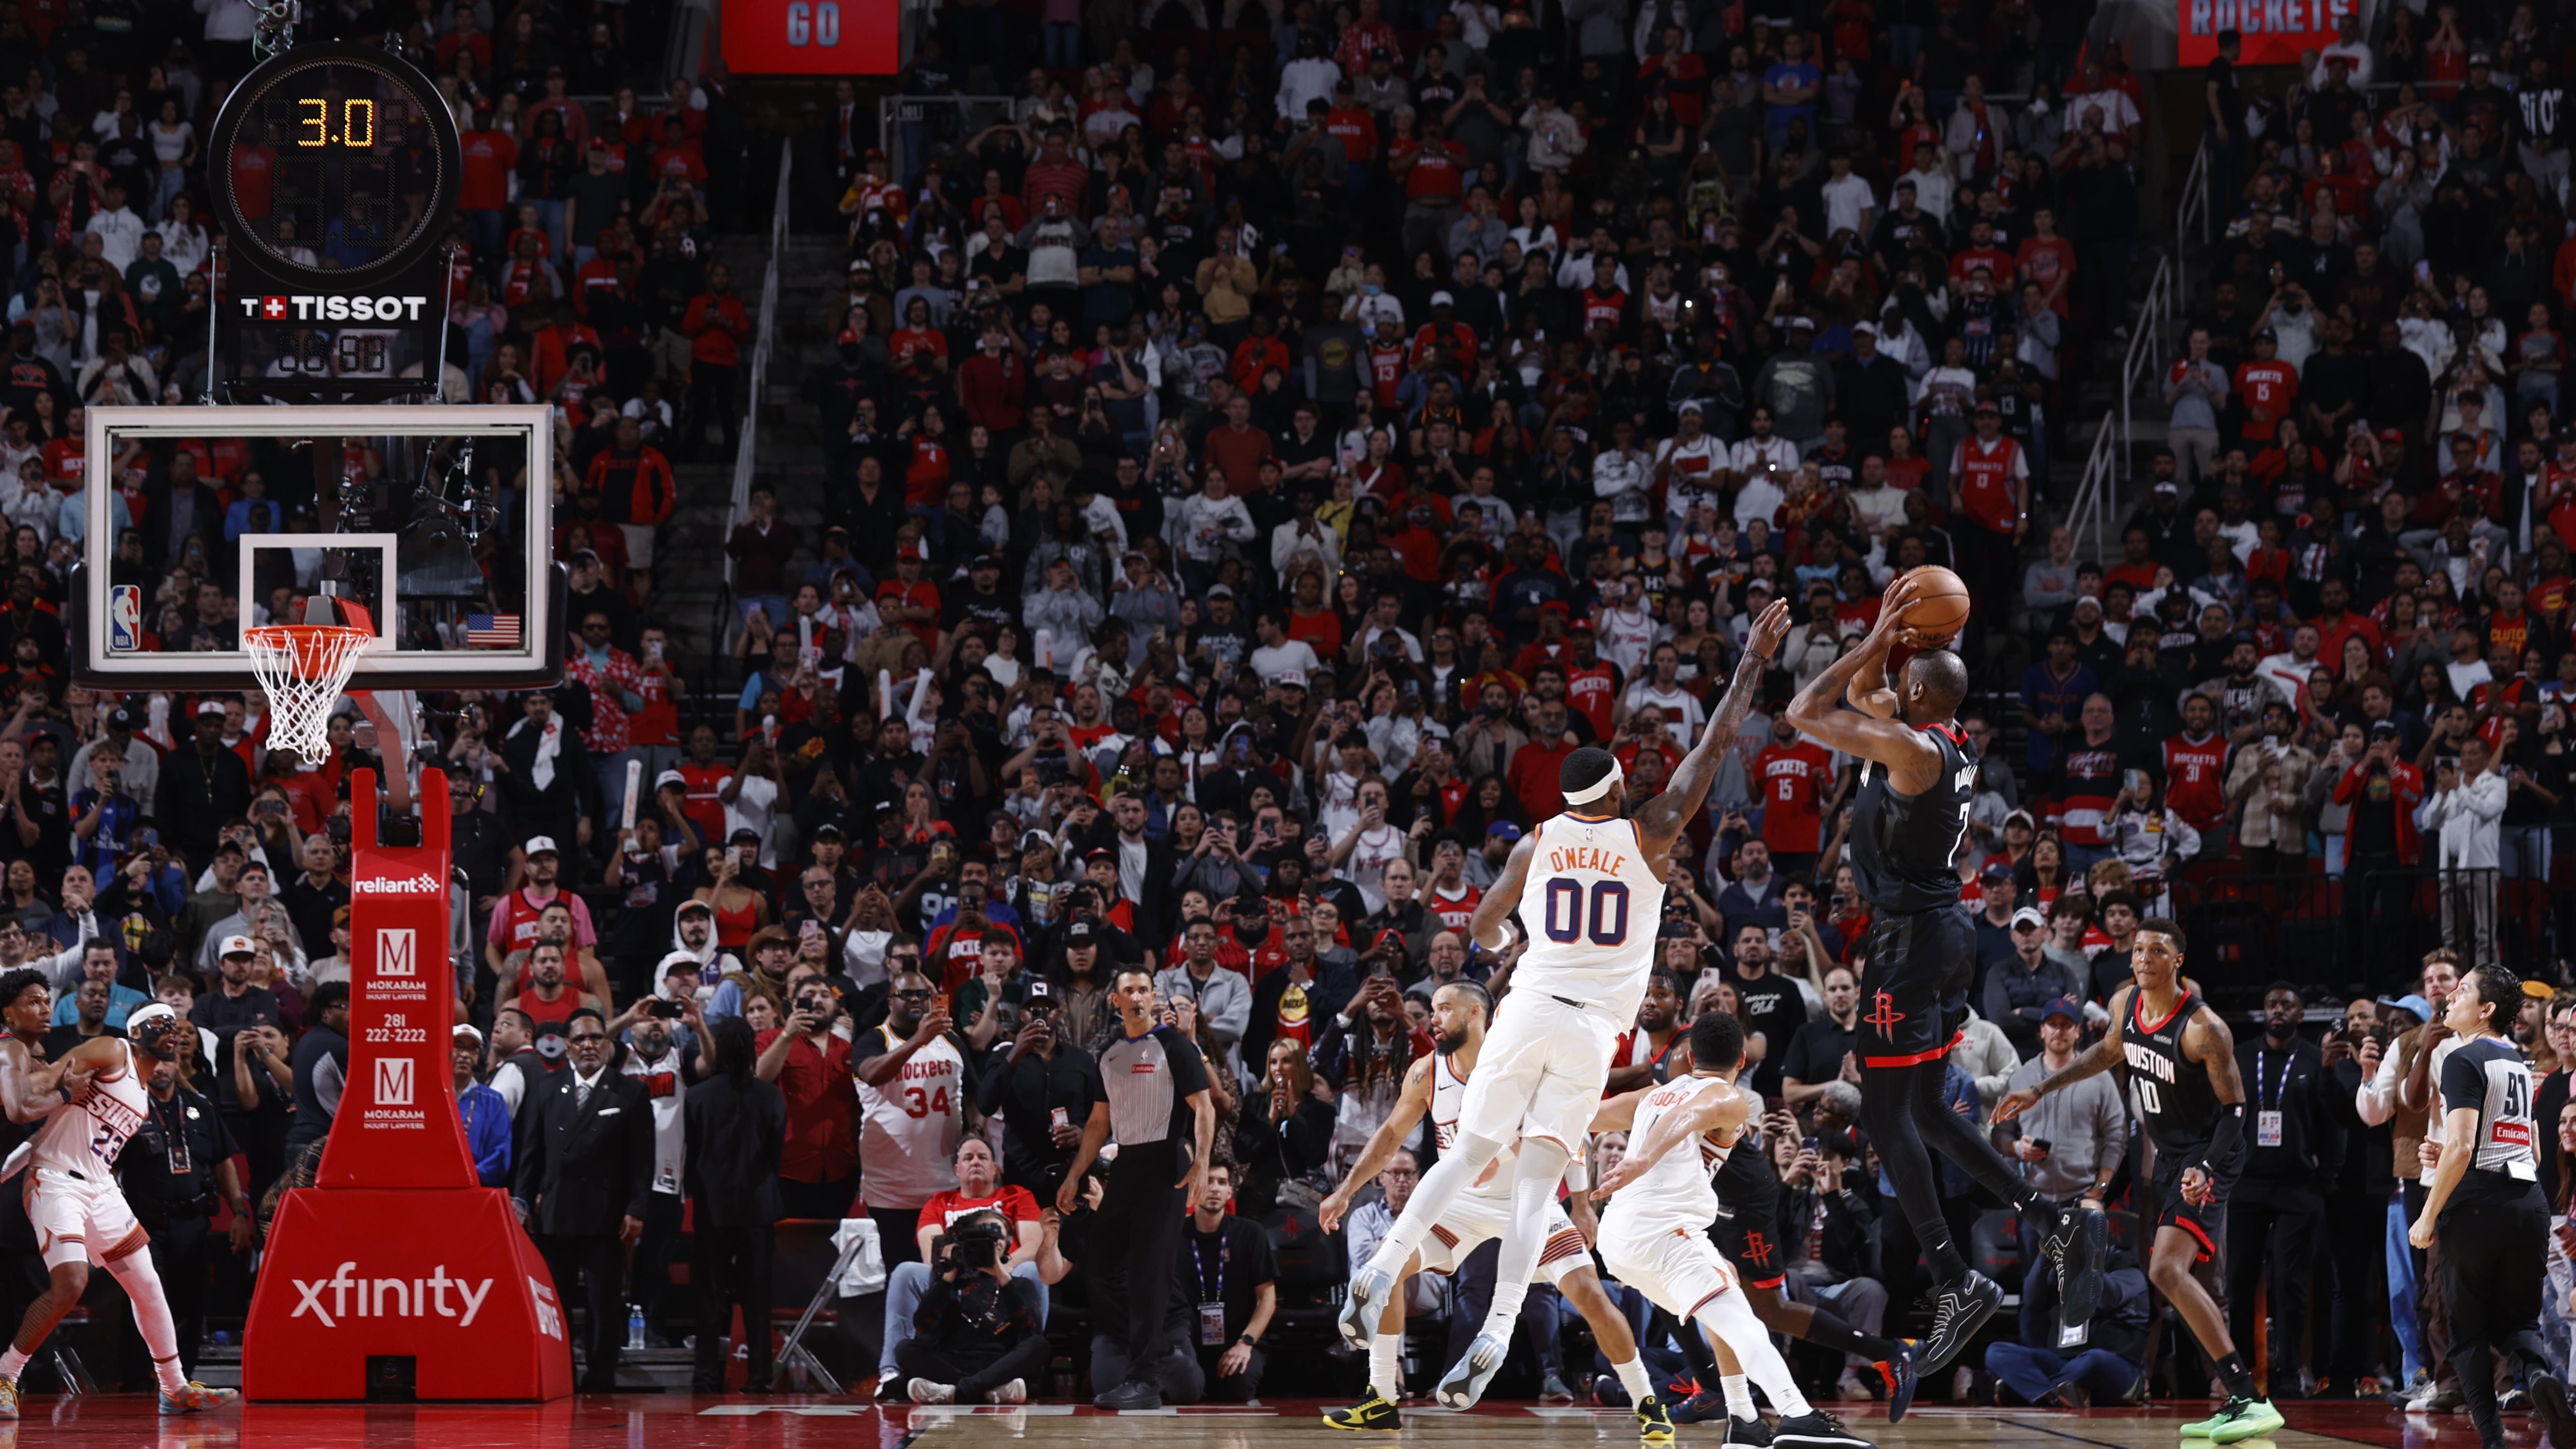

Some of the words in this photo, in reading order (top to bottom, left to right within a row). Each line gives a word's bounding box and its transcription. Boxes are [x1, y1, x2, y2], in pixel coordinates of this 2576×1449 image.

[788, 2, 840, 47] GO
[2190, 0, 2351, 36] ROCKETS
[298, 98, 374, 147] 3.0
[291, 296, 427, 321] TISSOT
[1586, 692, 1598, 713] 7
[1765, 759, 1808, 778] ROCKETS
[2173, 752, 2218, 766] ROCKETS
[2185, 765, 2200, 783] 31
[1777, 778, 1793, 801] 15
[1947, 802, 1971, 867] 7
[1550, 846, 1626, 877] O'NEALE
[356, 877, 418, 894] reliant
[1546, 877, 1630, 947] 00
[948, 940, 982, 959] ROCKE
[366, 981, 427, 991] MOKARAM
[384, 1014, 406, 1028] 281
[365, 1029, 427, 1042] 222-2222
[2123, 1040, 2175, 1084] HOUSTON
[905, 1086, 952, 1118] 34
[2139, 1077, 2161, 1114] 10
[2504, 1071, 2528, 1118] 91
[87, 1093, 143, 1139] SUNS
[364, 1110, 426, 1120] MOKARAM
[91, 1124, 124, 1166] 23
[2497, 1126, 2530, 1142] Emirates
[290, 1262, 495, 1327] xfinity
